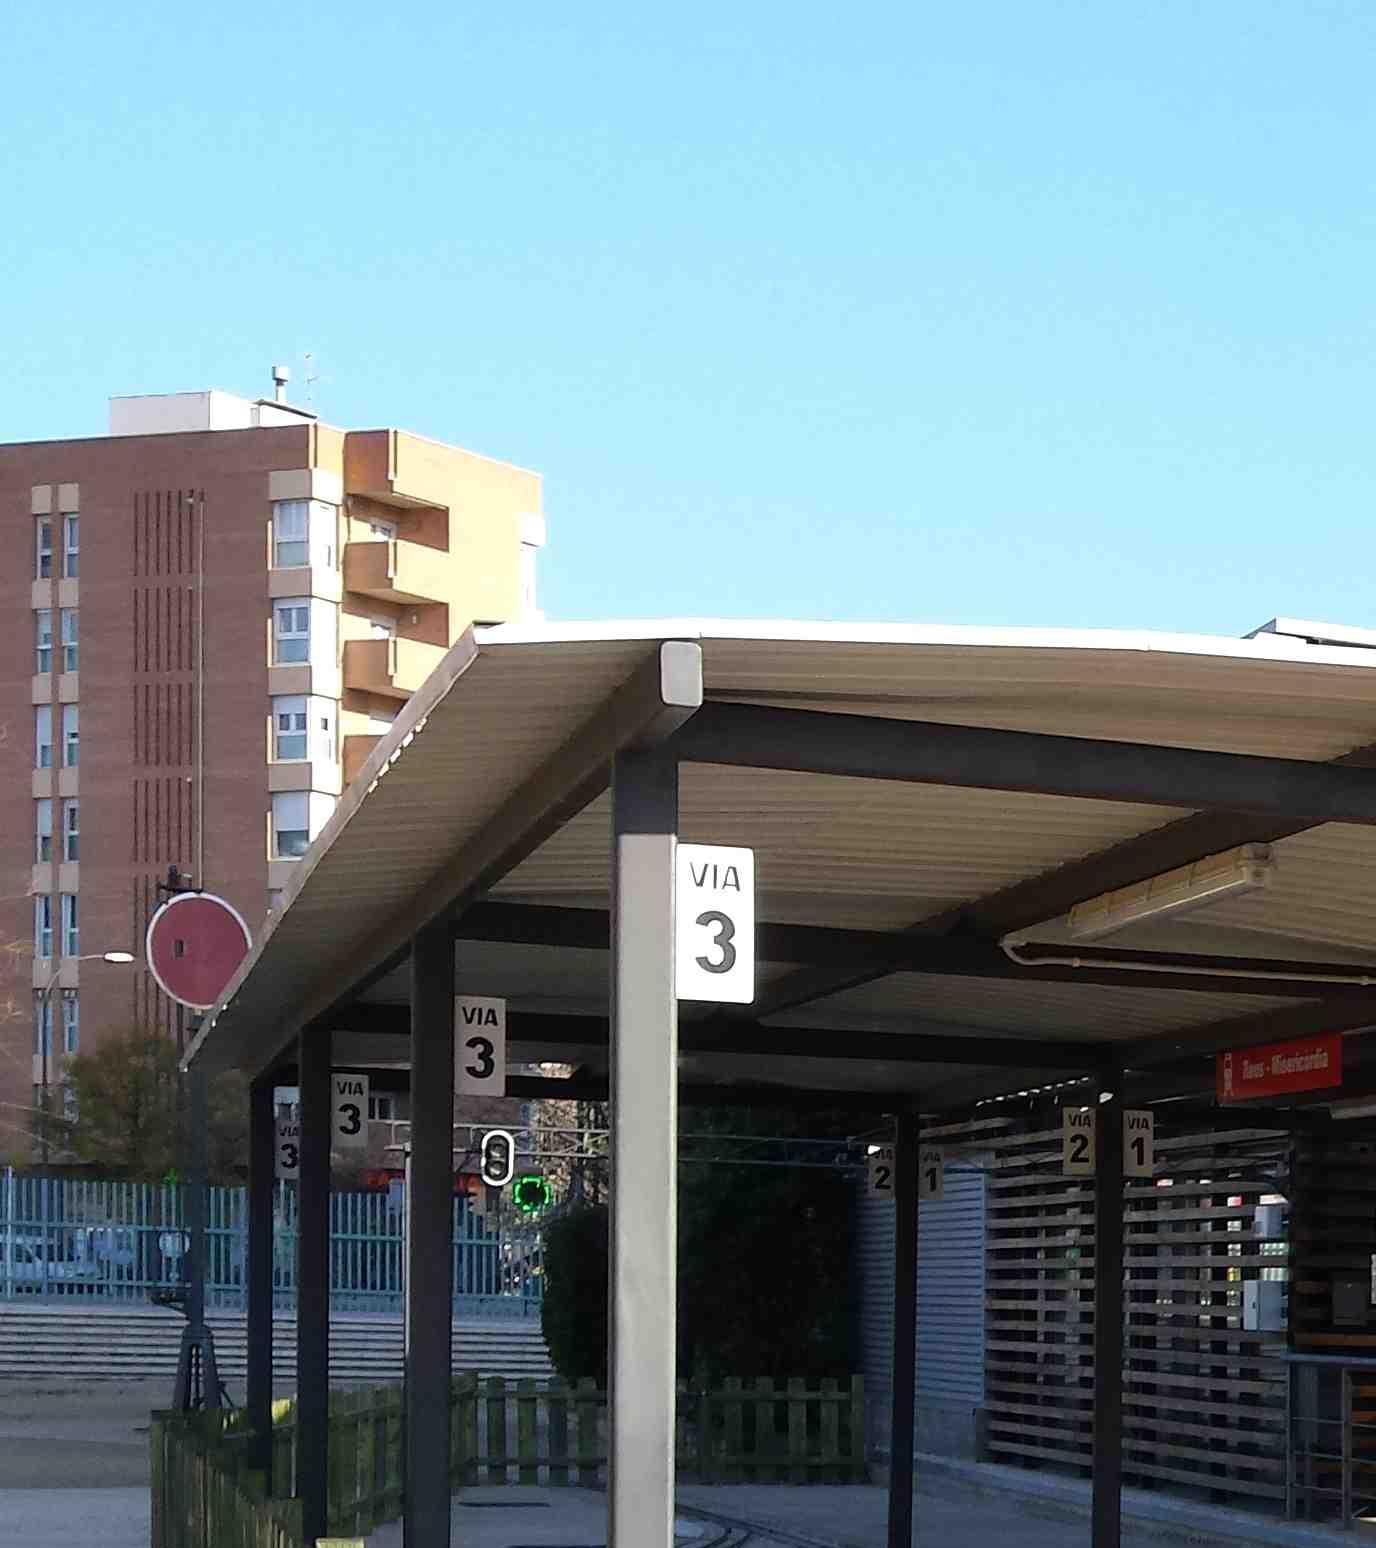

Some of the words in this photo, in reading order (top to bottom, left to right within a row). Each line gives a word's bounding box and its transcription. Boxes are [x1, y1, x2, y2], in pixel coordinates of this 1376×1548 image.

[688, 861, 741, 892] VIA
[695, 910, 737, 974] 3
[462, 1006, 498, 1026] VIA
[464, 1036, 495, 1078] 3
[336, 1081, 364, 1097] VIA
[338, 1103, 361, 1135] 3
[1068, 1113, 1092, 1128] VIA
[1127, 1115, 1150, 1130] VIA
[281, 1143, 298, 1168] 3
[1069, 1134, 1089, 1163] 2
[1130, 1137, 1145, 1165] 1
[875, 1166, 892, 1190] 2
[925, 1168, 937, 1192] 1
